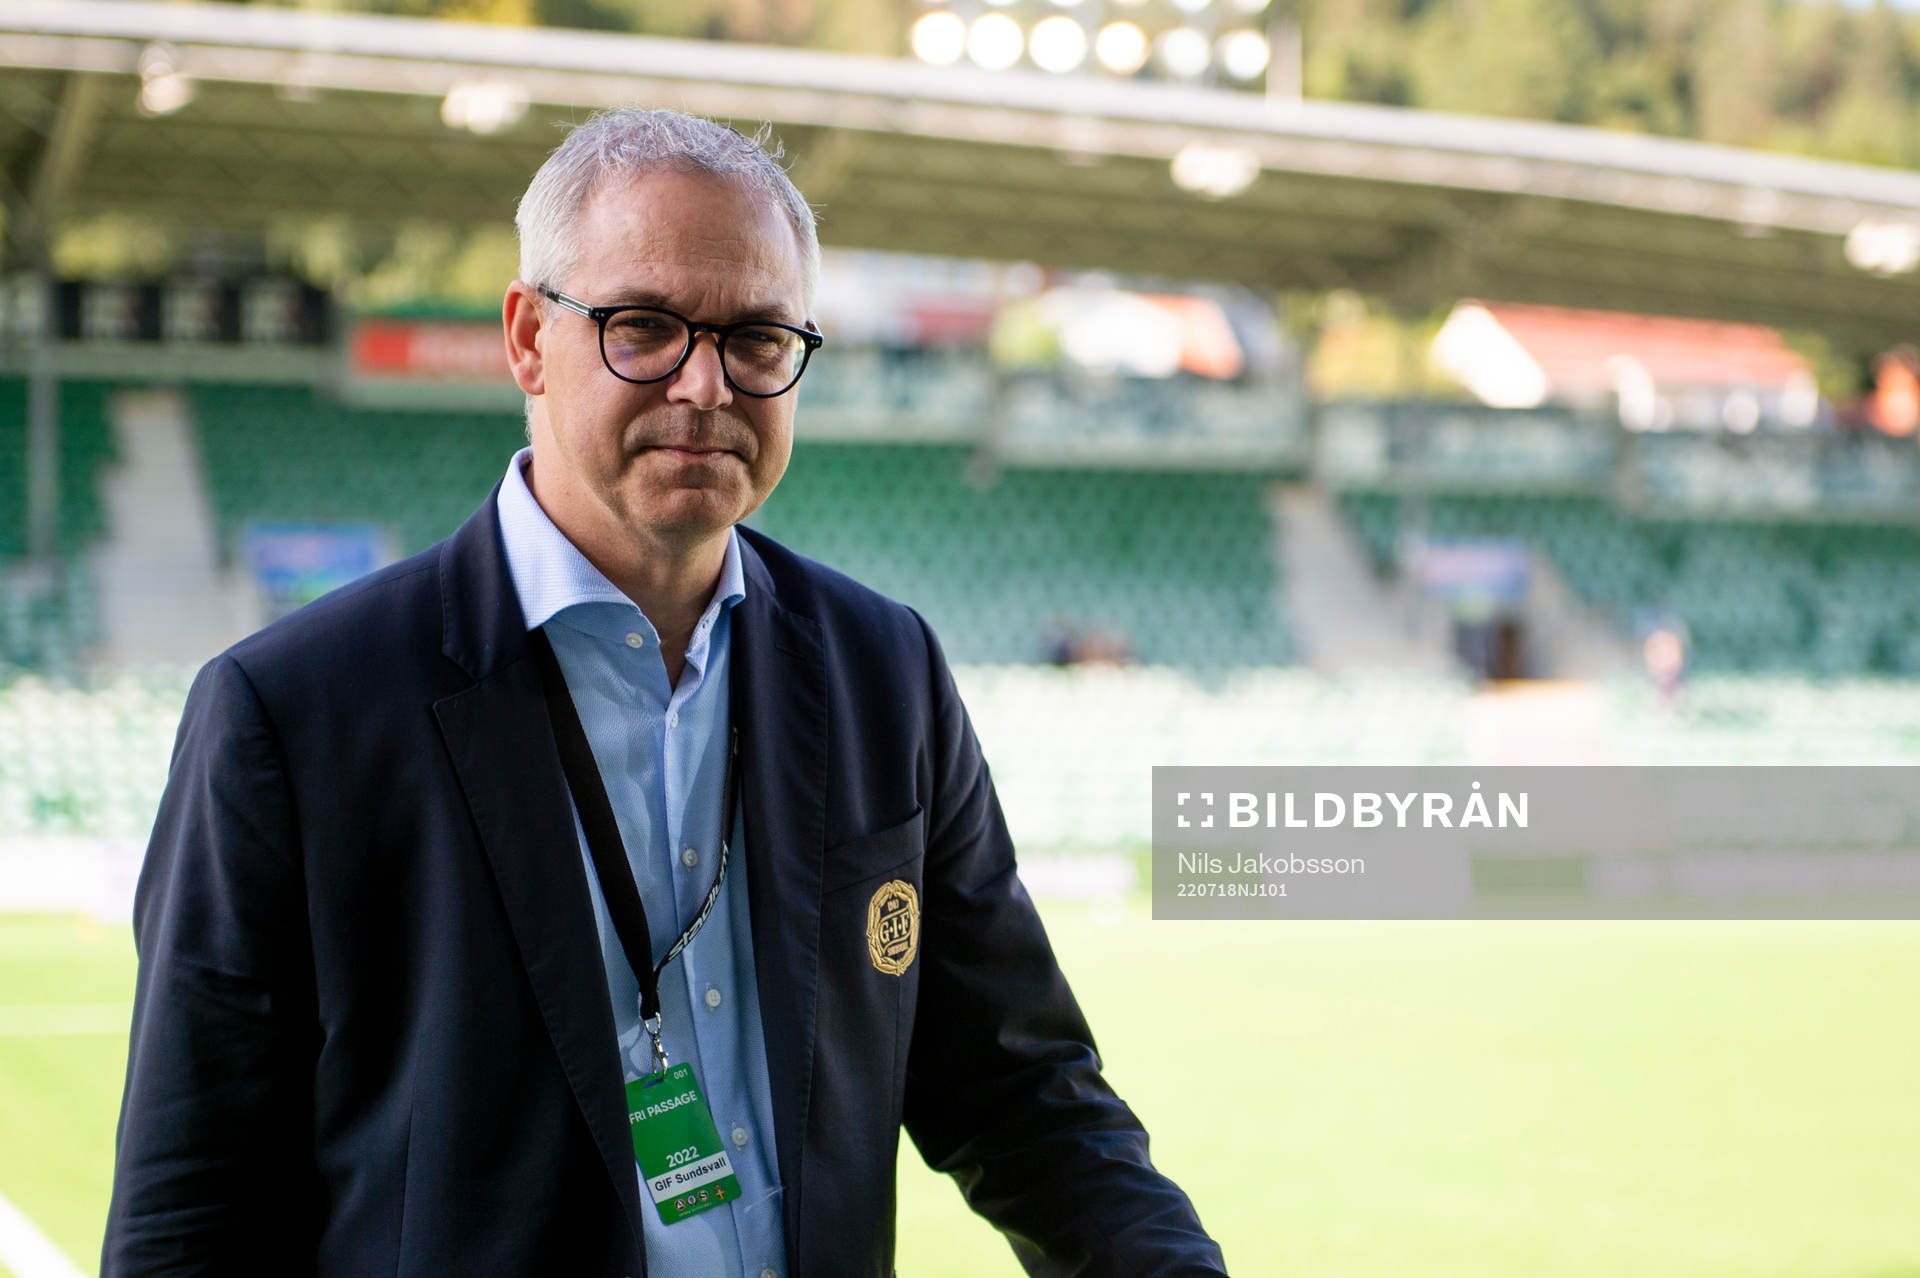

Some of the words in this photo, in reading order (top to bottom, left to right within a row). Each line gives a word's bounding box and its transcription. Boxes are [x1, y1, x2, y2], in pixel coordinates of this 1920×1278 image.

[673, 1068, 688, 1080] 001
[629, 1110, 646, 1125] FRI
[647, 1090, 698, 1117] PASSAGE
[666, 1146, 700, 1168] 2022
[654, 1178, 673, 1192] GIF
[674, 1157, 727, 1184] Sundsvall
